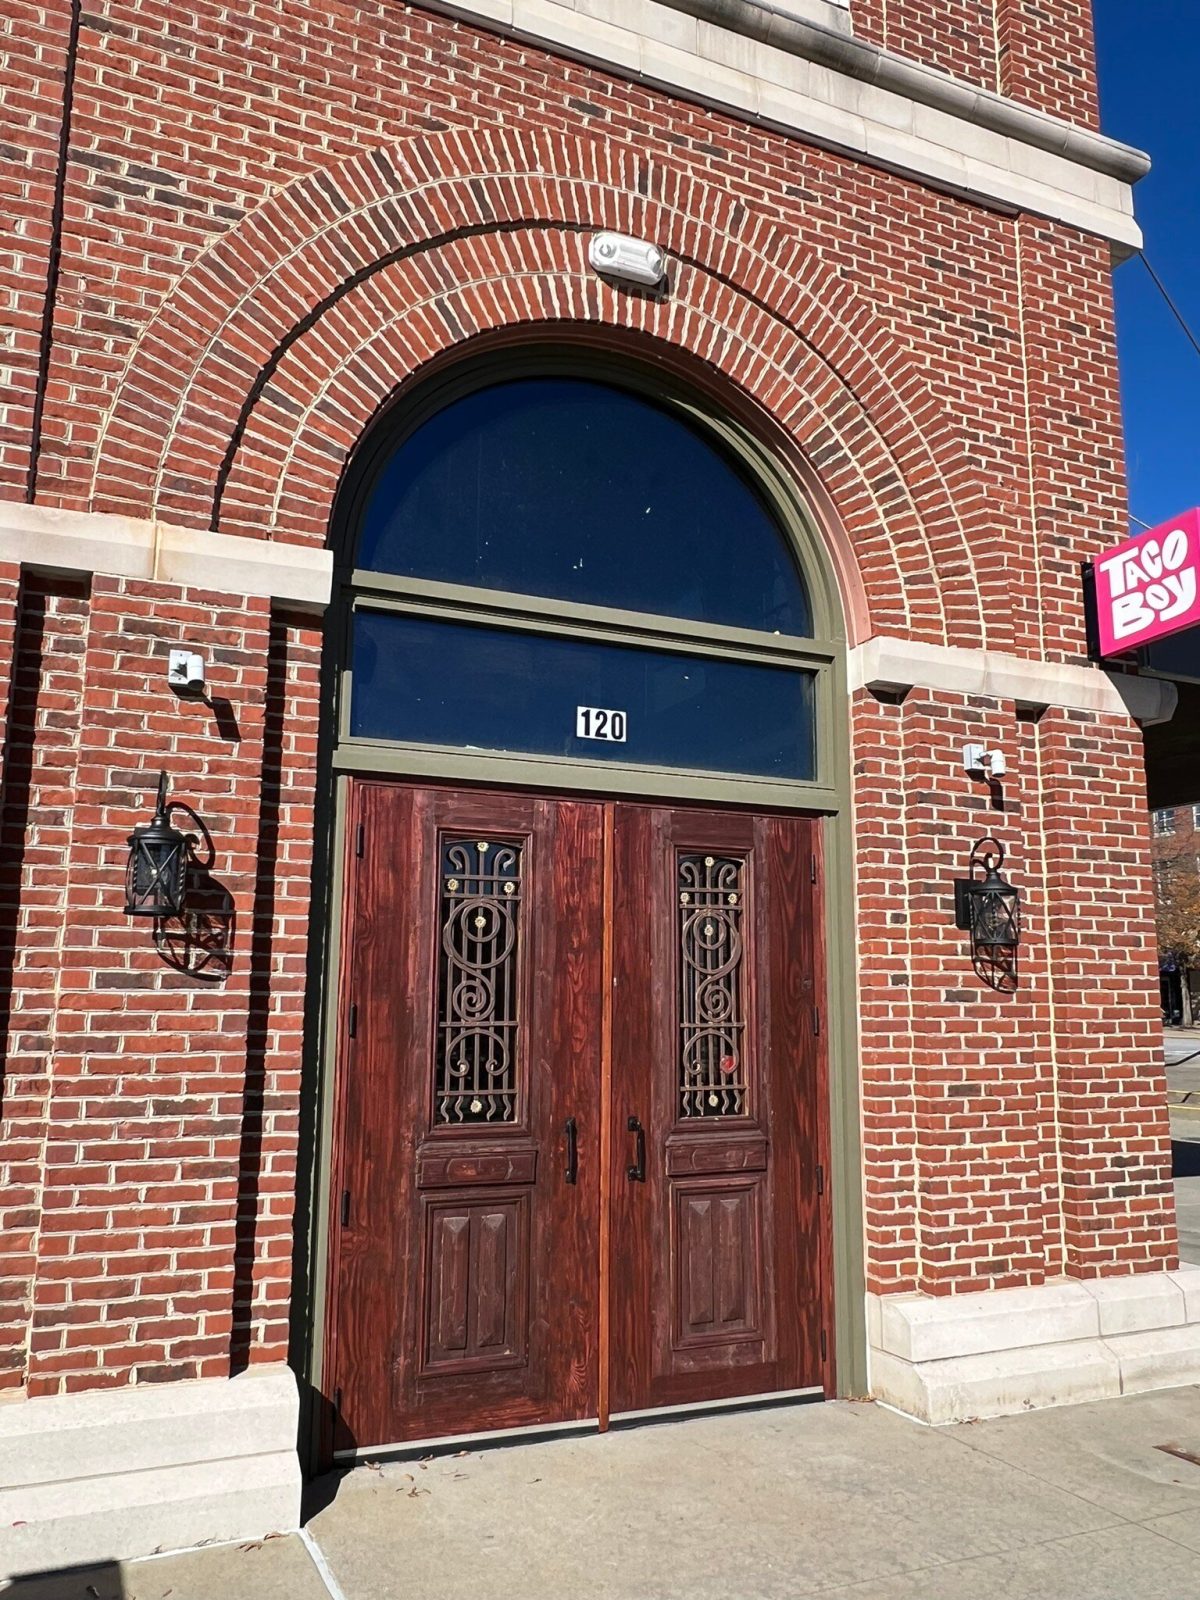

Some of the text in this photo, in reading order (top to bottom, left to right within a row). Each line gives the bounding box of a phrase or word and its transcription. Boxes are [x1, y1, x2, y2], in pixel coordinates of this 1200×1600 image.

[1100, 529, 1188, 598] TACO
[1112, 566, 1197, 640] BOY
[581, 709, 624, 740] 120
